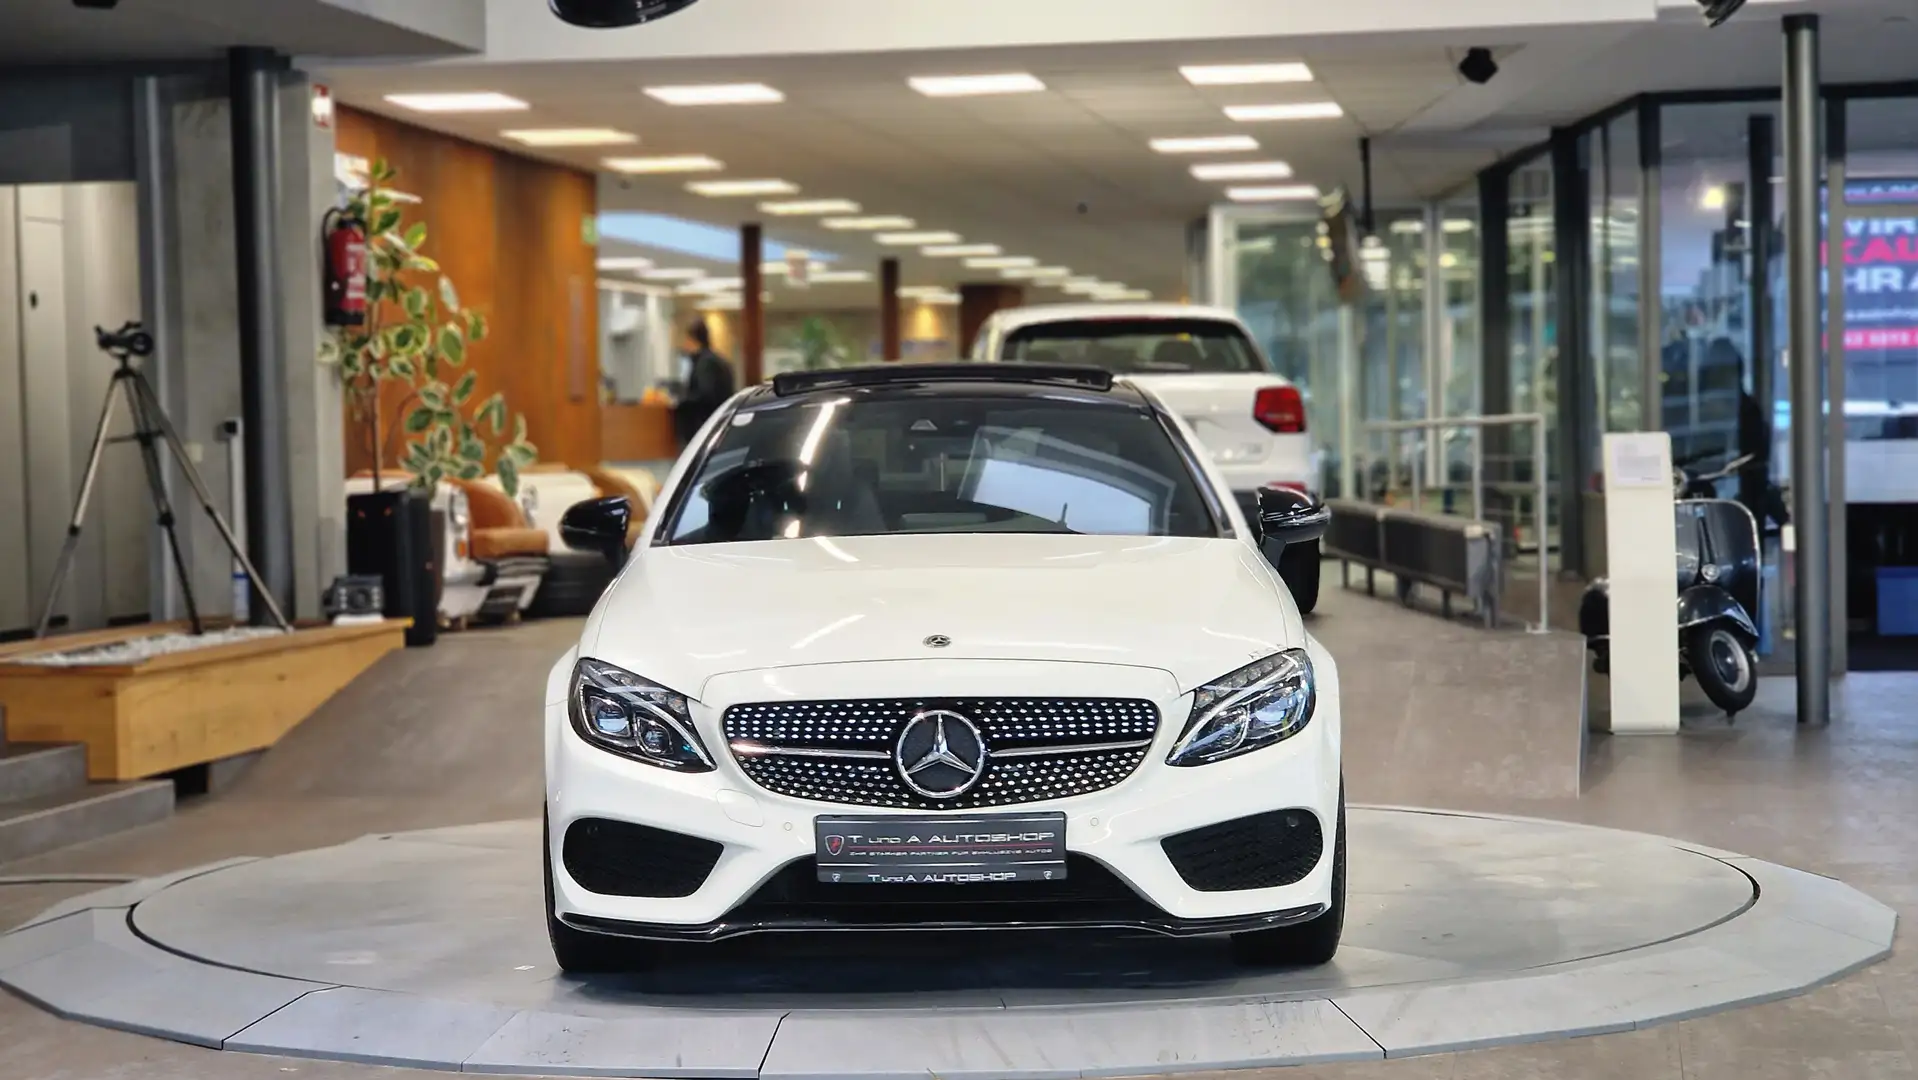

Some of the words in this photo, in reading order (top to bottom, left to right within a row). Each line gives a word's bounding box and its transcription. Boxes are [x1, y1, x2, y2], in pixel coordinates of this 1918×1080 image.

[847, 835, 863, 843] T
[906, 835, 921, 843] A
[928, 832, 1055, 843] AUTOSHOP
[923, 872, 1016, 882] AUTOSHOP
